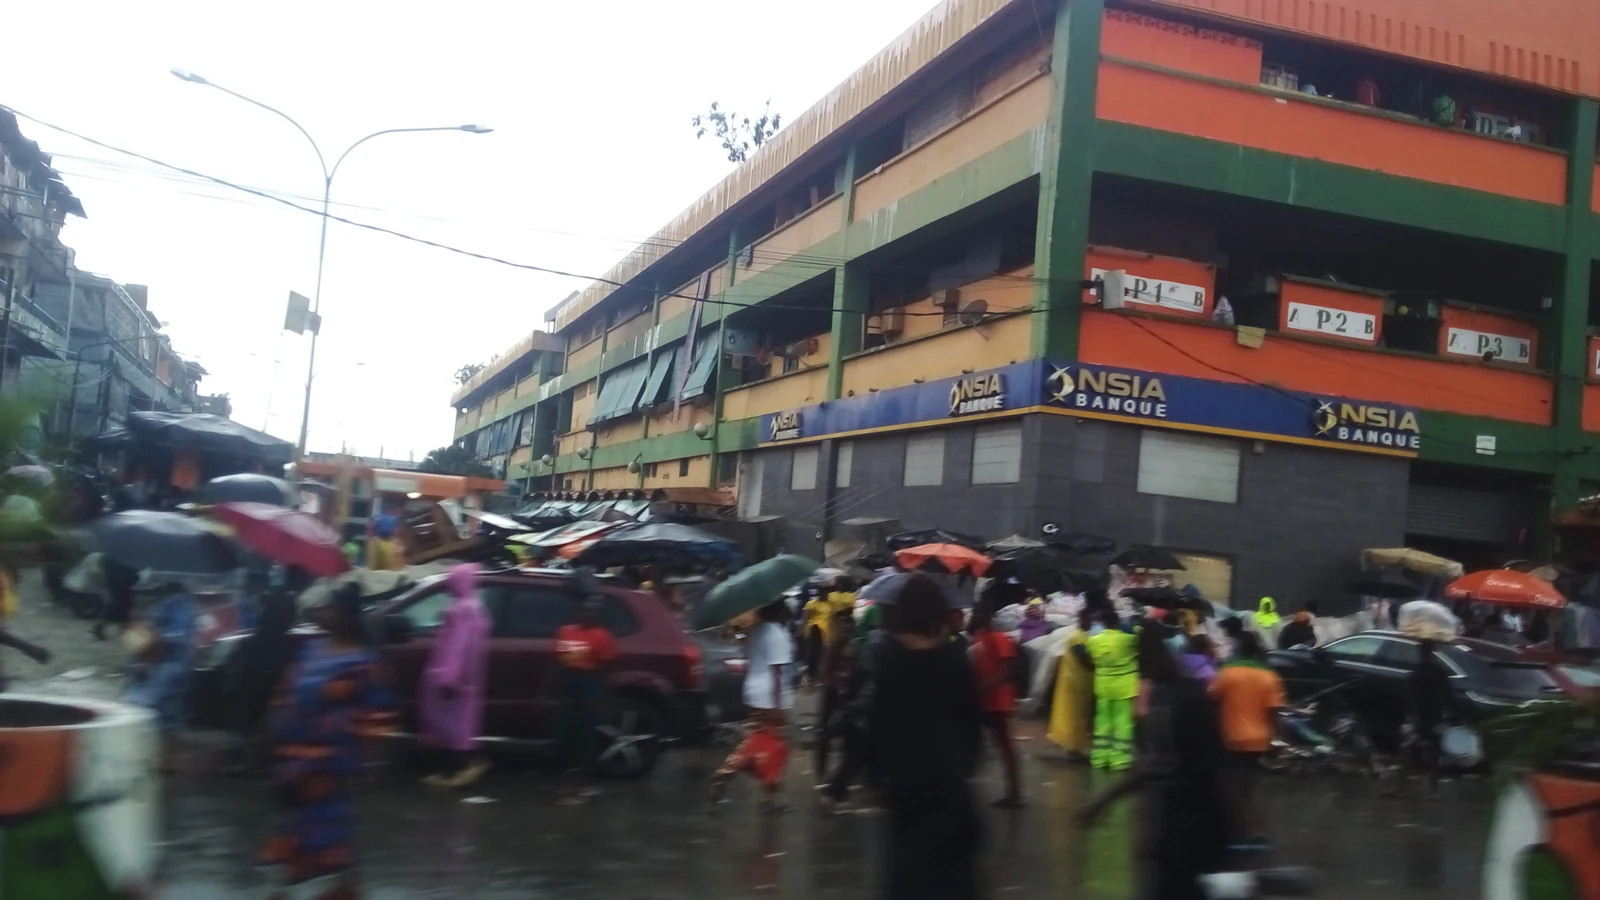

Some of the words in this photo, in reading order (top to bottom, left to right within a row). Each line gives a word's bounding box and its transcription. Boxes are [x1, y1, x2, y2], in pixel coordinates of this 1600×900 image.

[1193, 291, 1204, 307] B
[1288, 308, 1300, 322] A
[1364, 319, 1374, 334] B
[1518, 343, 1529, 358] B
[959, 373, 1001, 400] NSIA
[1077, 368, 1166, 401] NSIA
[1075, 393, 1167, 417] BANQUE
[1340, 403, 1420, 433] NSIA
[1338, 426, 1420, 449] BANQUE
